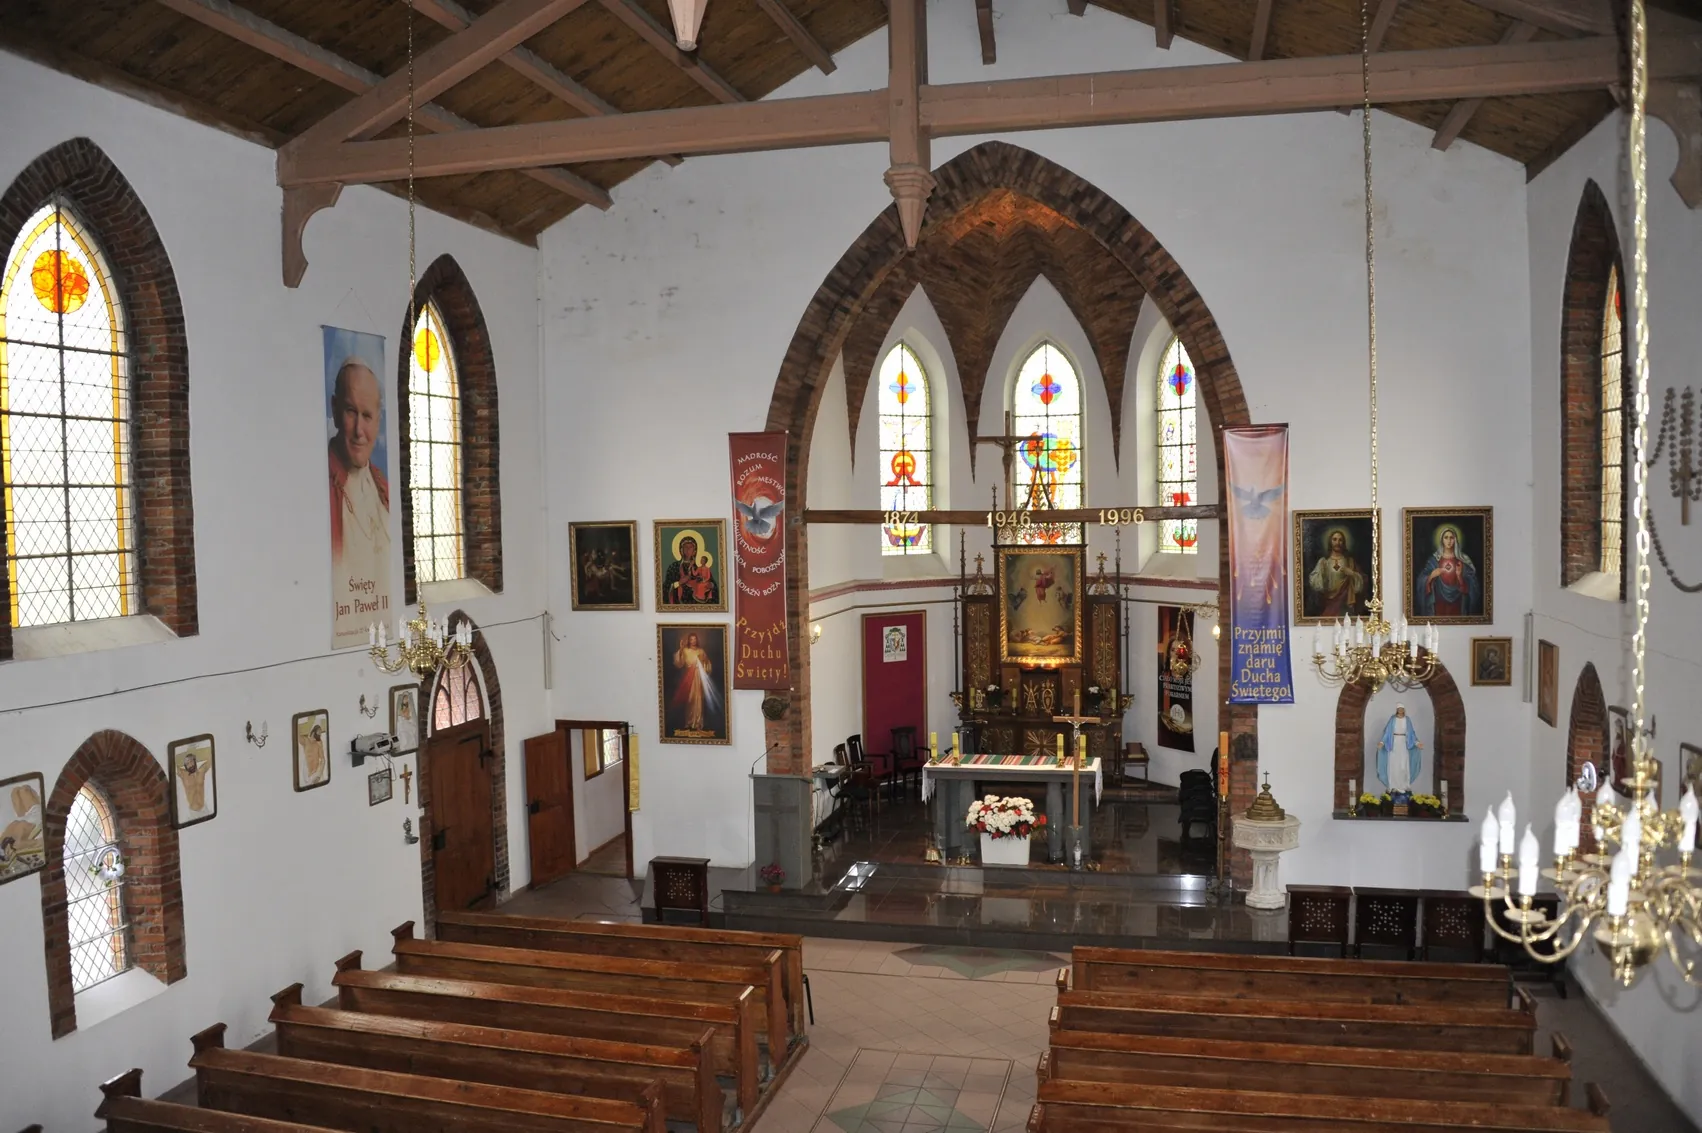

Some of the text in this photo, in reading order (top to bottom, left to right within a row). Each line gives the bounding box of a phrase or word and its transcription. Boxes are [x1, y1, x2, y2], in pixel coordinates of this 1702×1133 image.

[736, 463, 763, 486] ROZUM
[883, 511, 919, 526] 1874
[986, 511, 1031, 528] 1946
[1099, 508, 1145, 526] 1996
[348, 576, 376, 595] Święty
[335, 594, 388, 621] Jan Paweł II
[1234, 625, 1286, 644] Przyjmij
[742, 643, 781, 659] Duchu
[1238, 640, 1283, 656] znamię
[1246, 654, 1276, 668] daru
[737, 660, 787, 683] Święty!
[1241, 668, 1281, 683] Ducha
[1231, 680, 1292, 702] Świętego!
